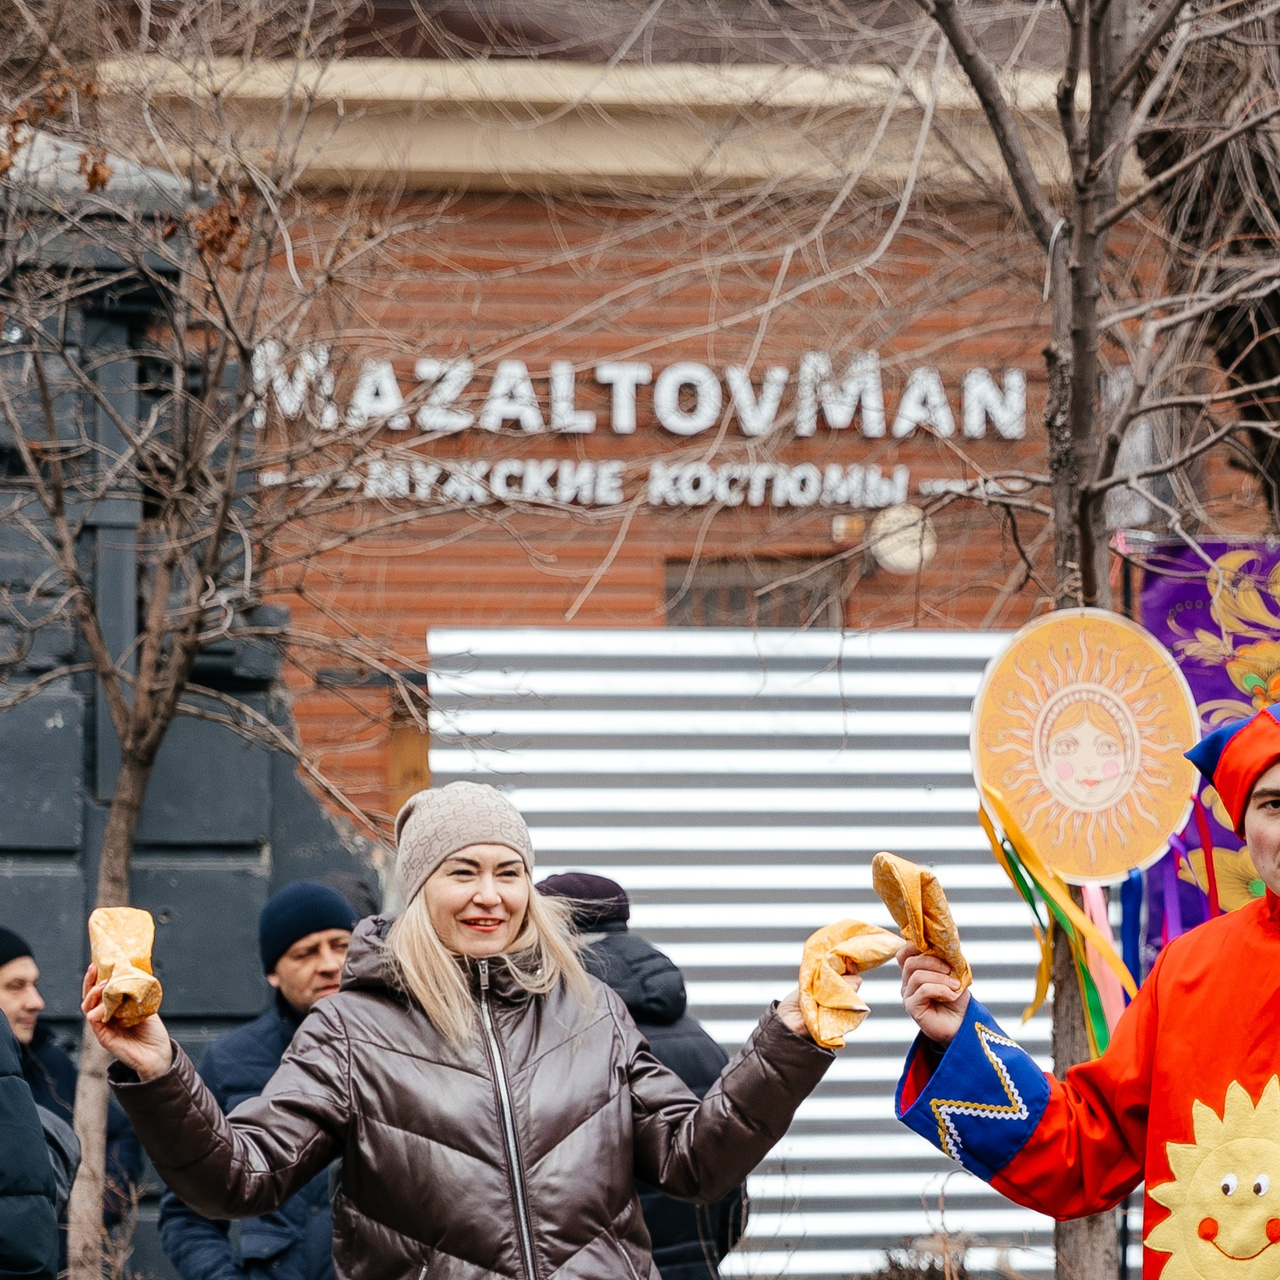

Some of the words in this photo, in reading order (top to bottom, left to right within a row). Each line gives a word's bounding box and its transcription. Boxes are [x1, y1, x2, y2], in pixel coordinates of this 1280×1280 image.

[252, 337, 1028, 439] MAZALTOVMAN
[363, 458, 627, 506] МУЖСКИЕ
[647, 461, 910, 508] КОСТЮМЫ
